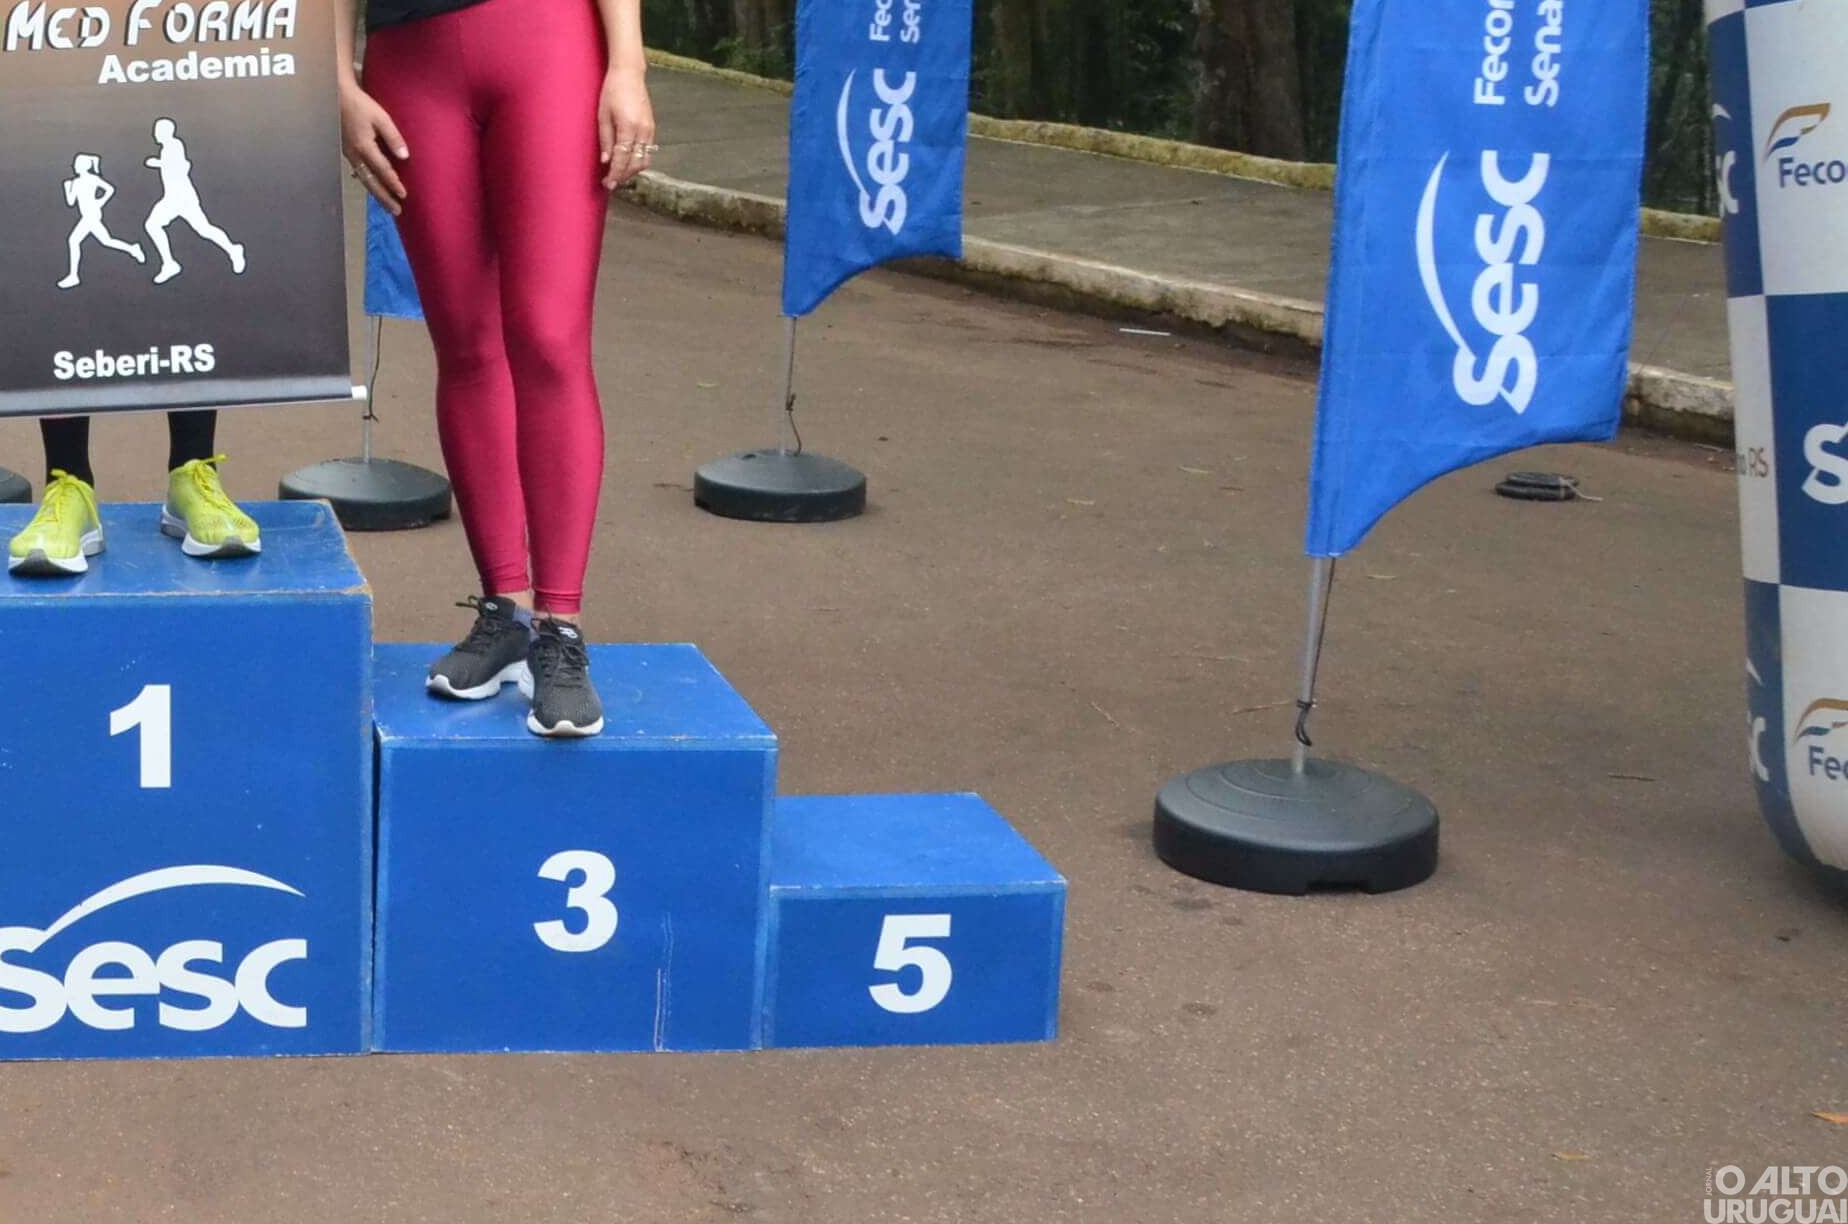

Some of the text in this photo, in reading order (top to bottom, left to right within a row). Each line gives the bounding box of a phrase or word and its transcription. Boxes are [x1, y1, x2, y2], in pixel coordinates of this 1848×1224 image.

[98, 47, 296, 85] Academia
[53, 343, 216, 380] Seberi-RS
[110, 684, 171, 788] 1
[533, 850, 618, 953] 3
[868, 914, 954, 1014] 5
